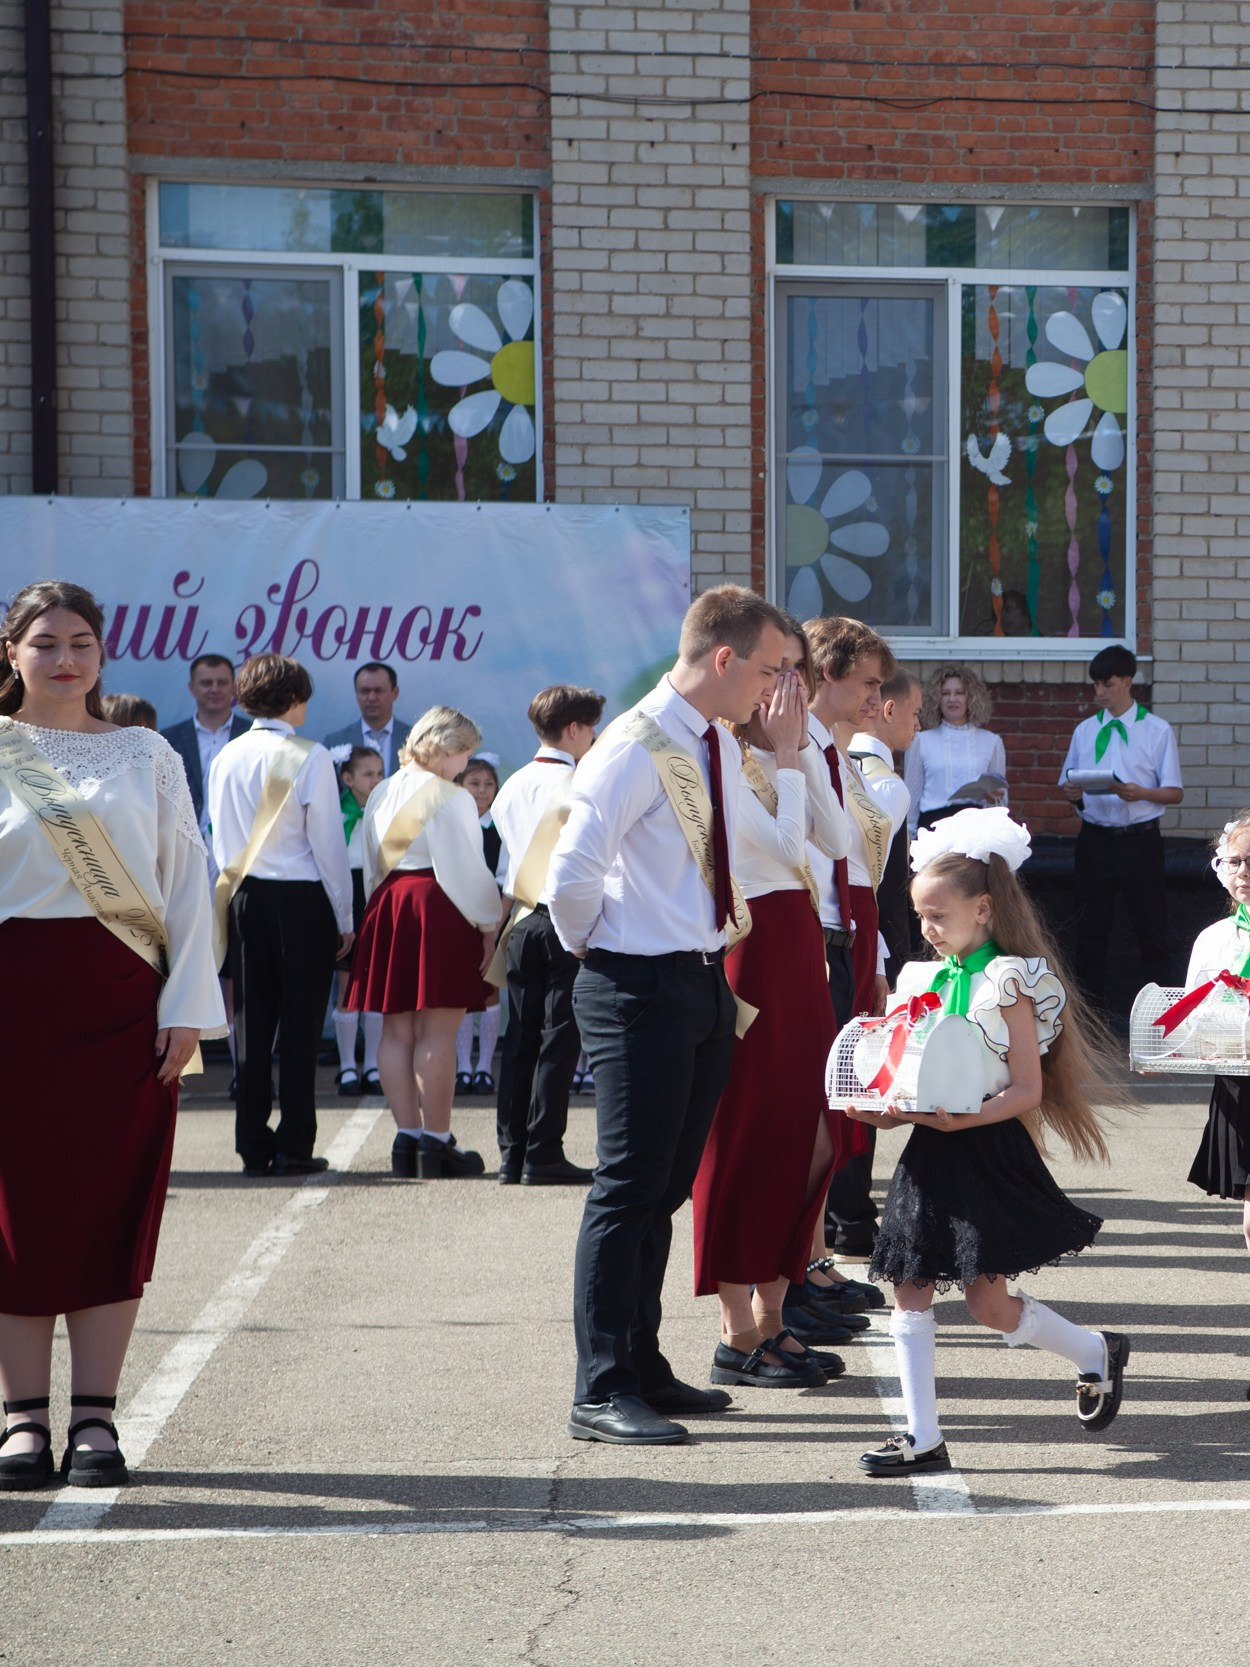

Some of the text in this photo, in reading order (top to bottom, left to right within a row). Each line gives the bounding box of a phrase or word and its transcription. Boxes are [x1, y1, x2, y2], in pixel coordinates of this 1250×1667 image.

[231, 558, 484, 669] звонок
[15, 768, 121, 900] Выпускница
[62, 847, 83, 880] Чёрная
